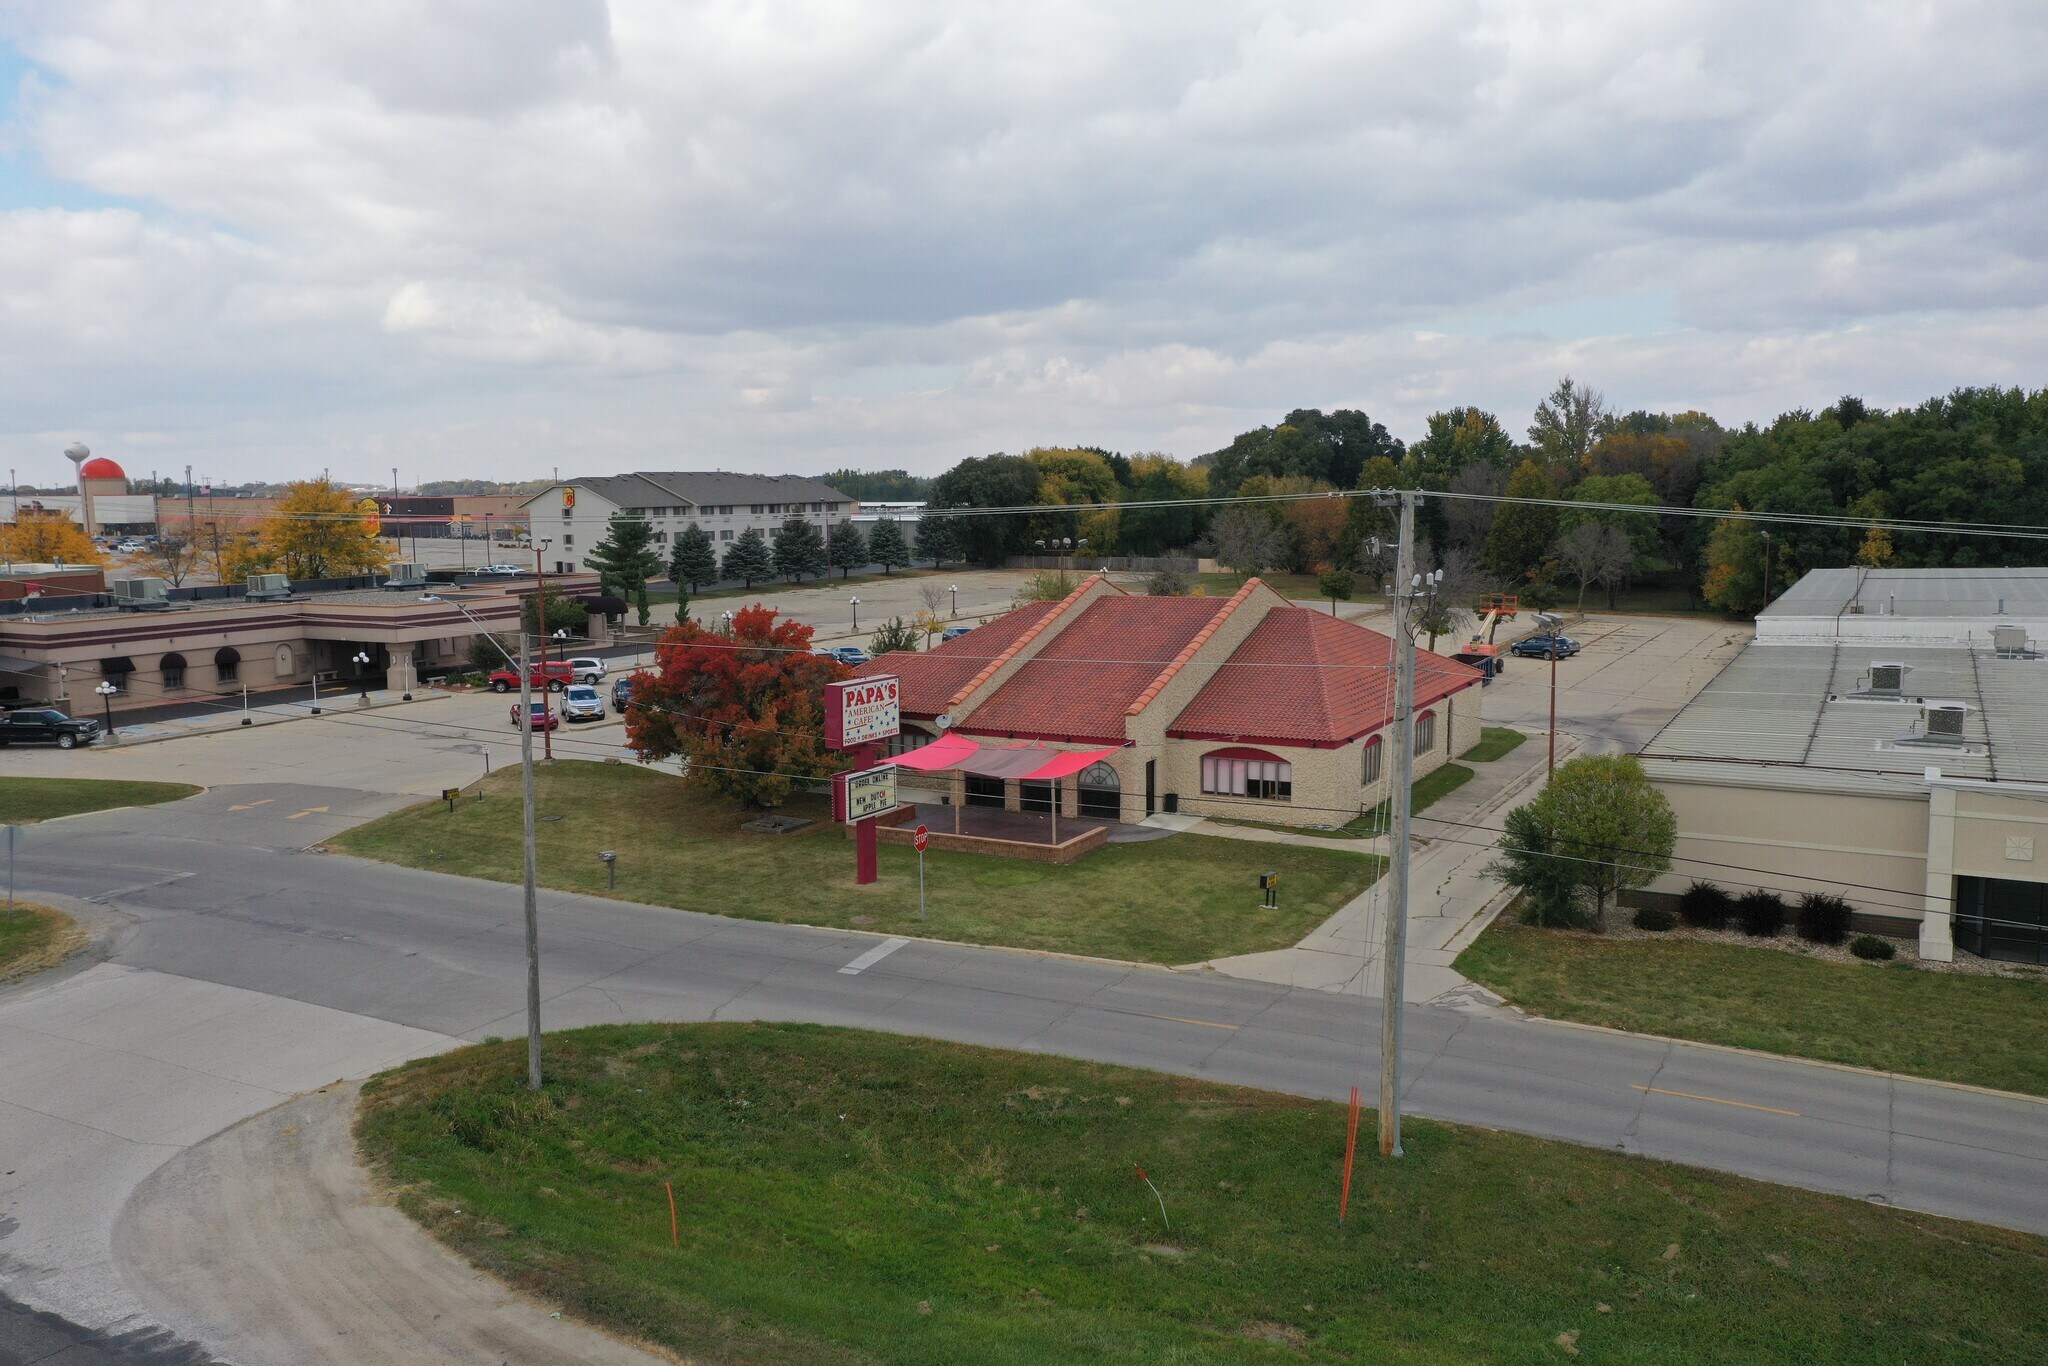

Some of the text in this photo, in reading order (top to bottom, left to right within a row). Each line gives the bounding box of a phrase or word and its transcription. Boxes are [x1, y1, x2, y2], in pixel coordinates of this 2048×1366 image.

[845, 683, 897, 708] PAPA'S
[848, 703, 885, 718] AMERICAN
[845, 727, 898, 745] FOOD DRINKS SPORTS
[855, 773, 888, 789] ORDER ONLINE
[856, 788, 886, 806] NEW DUTCH
[863, 801, 877, 812] APPLE
[915, 832, 928, 846] STOP
